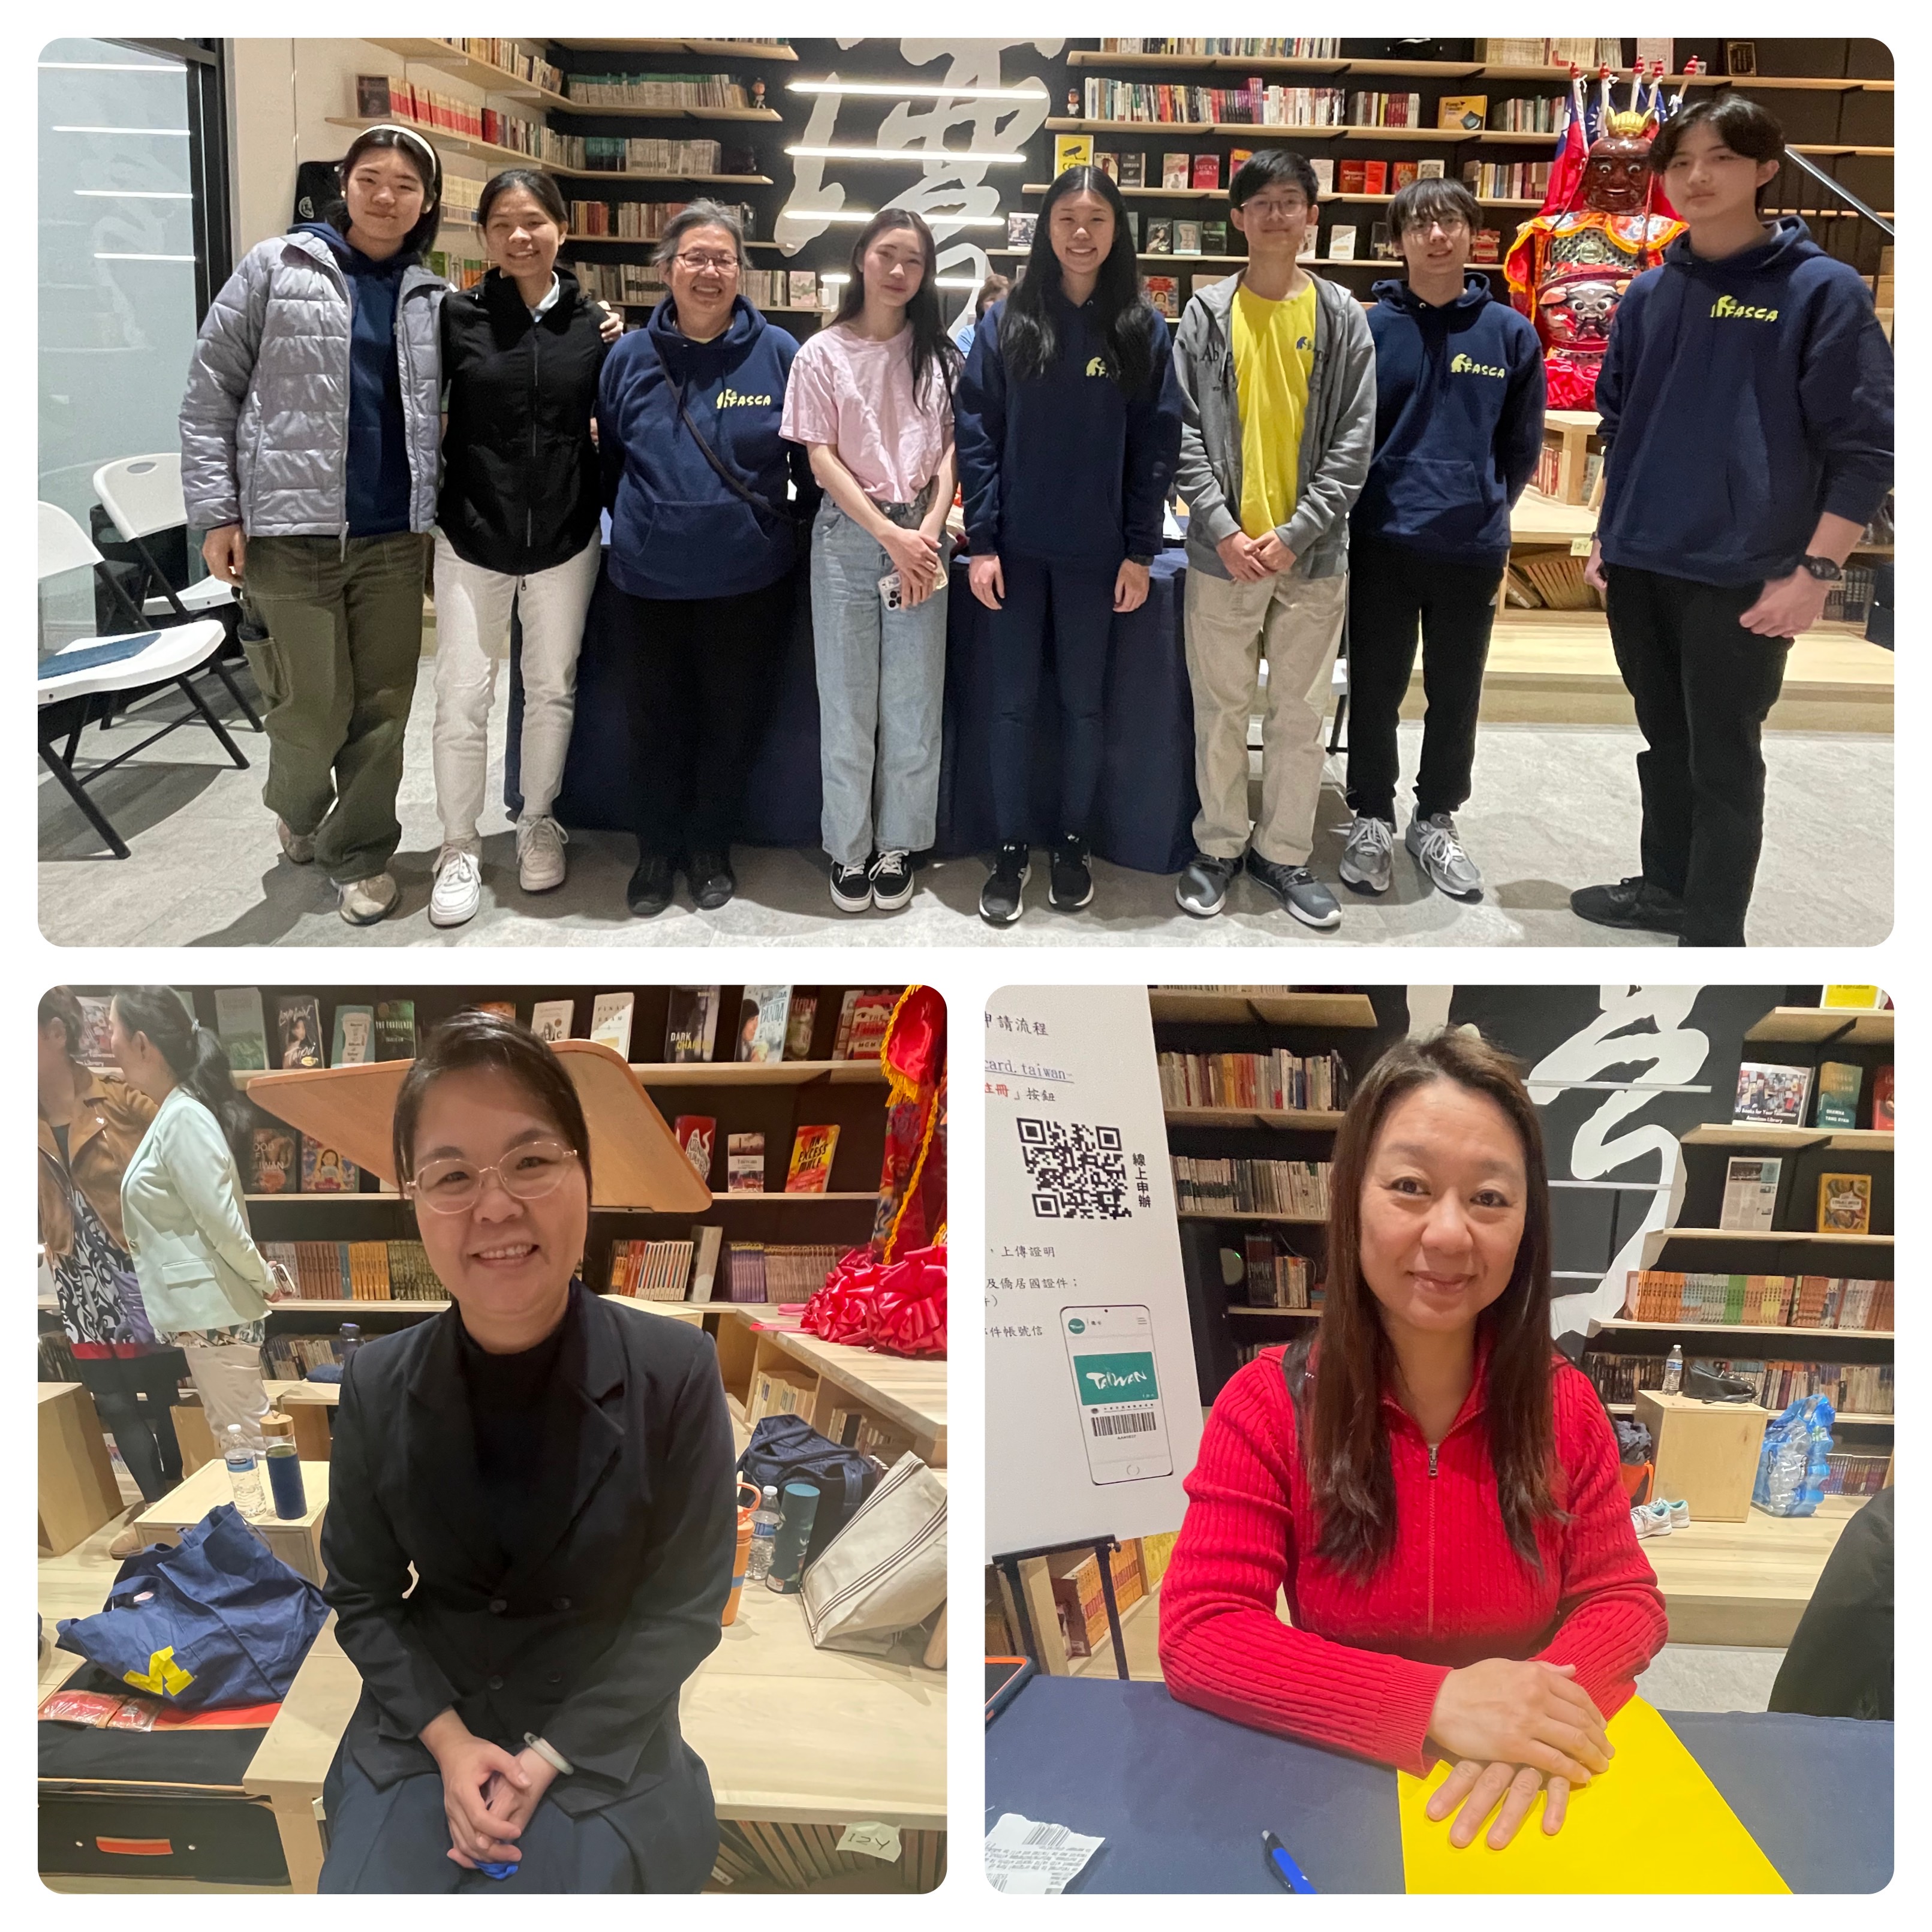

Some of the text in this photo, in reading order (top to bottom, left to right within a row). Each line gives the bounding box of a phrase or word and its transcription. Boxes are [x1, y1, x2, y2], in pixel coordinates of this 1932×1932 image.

[1725, 305, 1778, 322] FASCA
[1464, 363, 1505, 379] FASCA
[730, 395, 772, 407] FASCA
[760, 1002, 785, 1024] PANDA
[670, 1032, 691, 1042] DARK
[254, 1142, 275, 1151] OOD
[798, 1143, 828, 1163] EXCESS
[985, 1325, 1043, 1338] 件帳號信
[847, 1832, 890, 1851] 12Y
